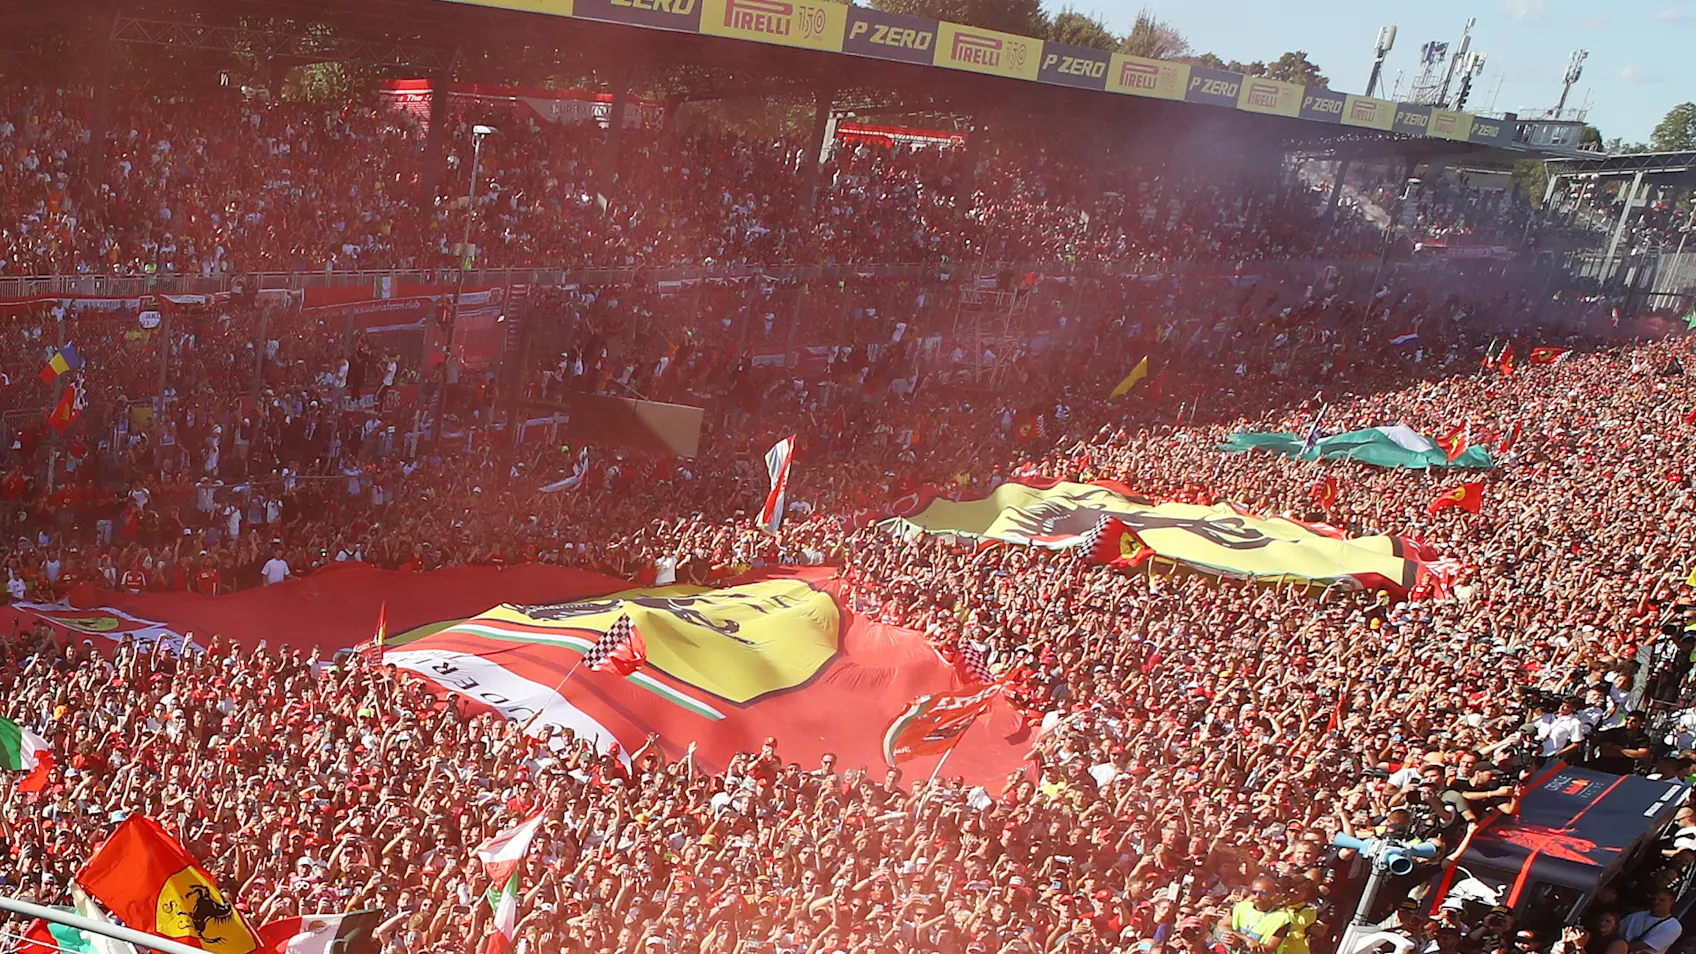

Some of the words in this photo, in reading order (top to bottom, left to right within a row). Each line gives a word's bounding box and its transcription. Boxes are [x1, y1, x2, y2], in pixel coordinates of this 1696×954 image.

[723, 0, 792, 36] PIRELLI
[849, 21, 868, 39] P
[870, 24, 932, 50] ZERO
[951, 32, 1002, 67] PIRELLI
[1042, 54, 1056, 71] P
[1058, 57, 1106, 79] ZERO
[1119, 61, 1159, 90] PIRELLI
[1189, 77, 1201, 91] P
[1201, 78, 1238, 98] ZERO
[1303, 97, 1313, 109] P
[1312, 98, 1342, 114] ZERO
[1395, 111, 1403, 123] P
[1403, 112, 1429, 127] ZERO
[1479, 124, 1499, 138] ZERO
